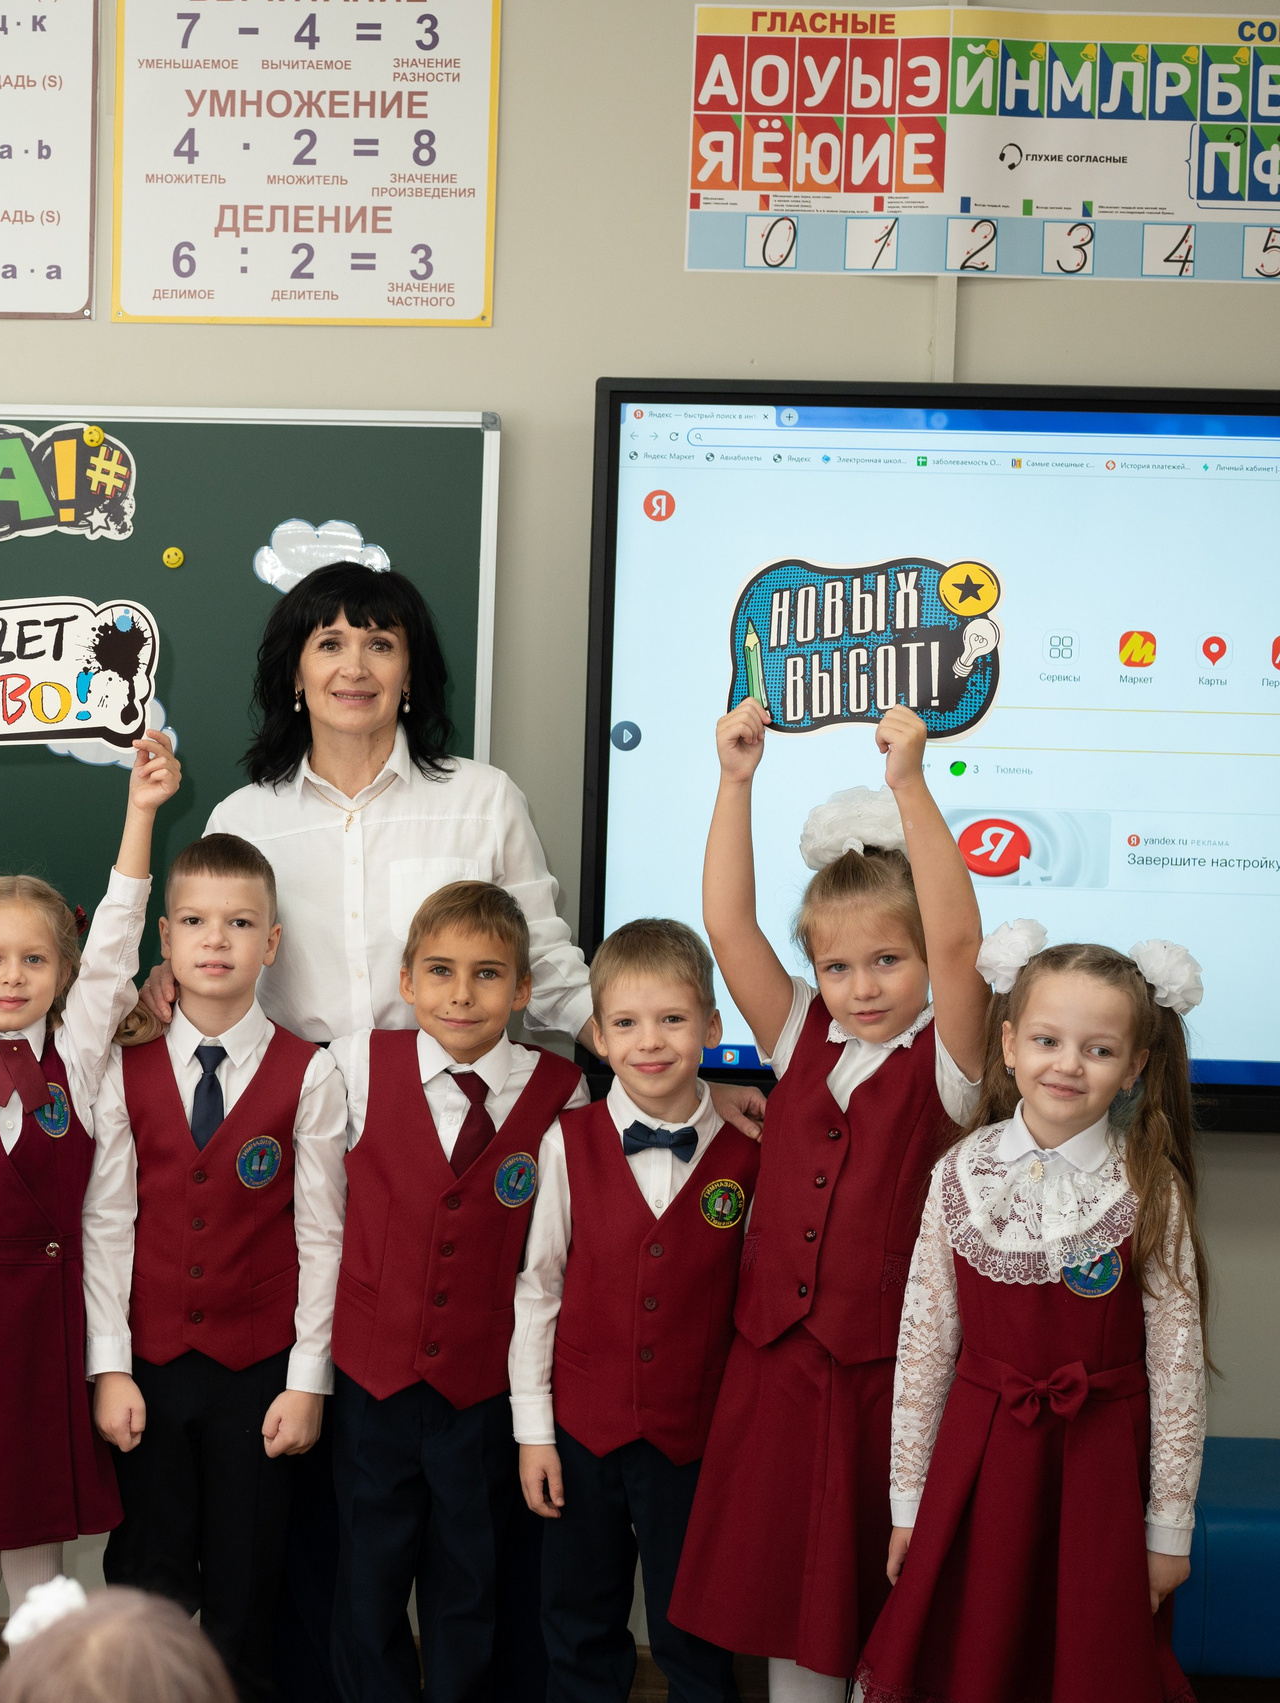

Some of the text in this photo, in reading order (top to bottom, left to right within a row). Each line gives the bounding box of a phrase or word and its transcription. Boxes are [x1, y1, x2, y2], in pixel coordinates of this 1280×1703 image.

[751, 11, 896, 34] ГЛАСНЫЕ
[176, 12, 440, 52] 7 4 3
[137, 58, 239, 70] УМЕНЬШАЕМОЕ
[261, 59, 352, 71] ВЫЧИТАЕМОЕ
[392, 57, 461, 69] ЗНАЧЕНИЕ
[392, 71, 461, 83] РАЗНОСТИ
[184, 89, 429, 119] УМНОЖЕНИЕ
[173, 127, 437, 167] 4 2 8
[1025, 153, 1128, 164] ГЛУХИЕ СОГЛАСНЫЕ
[145, 173, 227, 185] МНОЖИТЕЛЬ
[266, 174, 349, 186] МНОЖИТЕЛЬ
[389, 172, 458, 184] ЗНАЧЕНИЕ
[371, 186, 476, 200] ПРОИЗВЕДЕНИЯ
[213, 204, 393, 239] ДЕЛЕНИЕ
[762, 217, 797, 268] 0
[874, 217, 899, 270] 1
[960, 219, 997, 271] 2
[1056, 222, 1094, 274] 3
[1163, 224, 1195, 277] 4
[172, 240, 434, 281] 6 2 3
[387, 282, 456, 294] ЗНАЧЕНИЕ
[152, 288, 215, 301] ДЕЛИМОЕ
[270, 289, 340, 302] ДЕЛИТЕЛЬ
[386, 295, 456, 308] ЧАСТНОГО
[648, 411, 673, 419] Яндекс
[683, 411, 715, 420] быстрый
[643, 452, 696, 462] Яндекс Маркет
[720, 453, 763, 462] Авиабилеты
[787, 455, 812, 463] Яндекс
[836, 456, 882, 465] Электронная
[931, 458, 989, 467] заболеваемость
[1026, 459, 1050, 468] Самые
[1120, 461, 1151, 470] История
[1215, 463, 1274, 473] Личный кабинет
[770, 571, 919, 648] НОВЫХ
[786, 641, 941, 722] ВЫСОТ!
[1039, 672, 1081, 684] Сервисы
[1119, 675, 1154, 685] Маркет
[1198, 676, 1228, 687] Карты
[973, 764, 980, 774] 3
[995, 765, 1033, 775] Тюмень
[1143, 836, 1188, 847] yandex.ru
[1190, 838, 1230, 847] РЕКЛАМА
[1127, 852, 1207, 868] Завершите
[704, 1182, 737, 1197] ГИМНАЗИЯ
